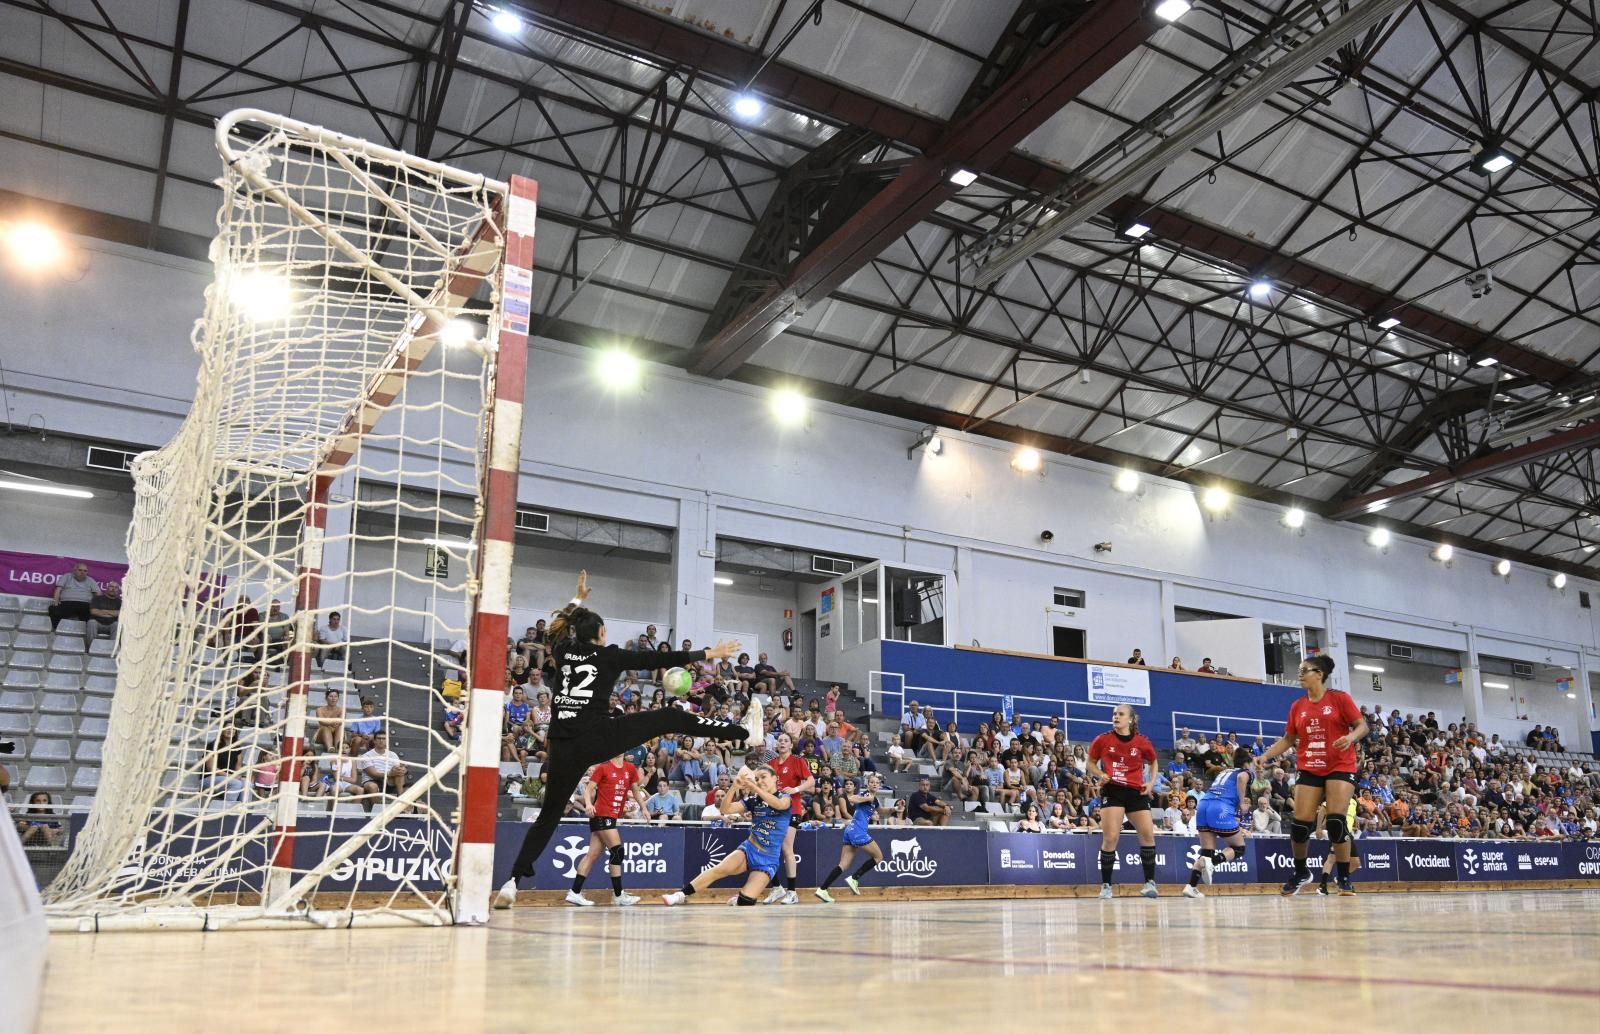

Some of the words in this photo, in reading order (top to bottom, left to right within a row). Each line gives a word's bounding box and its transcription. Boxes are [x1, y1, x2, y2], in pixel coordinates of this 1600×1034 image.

[560, 664, 599, 698] 12
[1043, 850, 1075, 859] Donostia
[1482, 851, 1504, 862] super
[1278, 854, 1324, 868] Occent
[1415, 854, 1450, 868] Occident
[1483, 862, 1507, 871] amara
